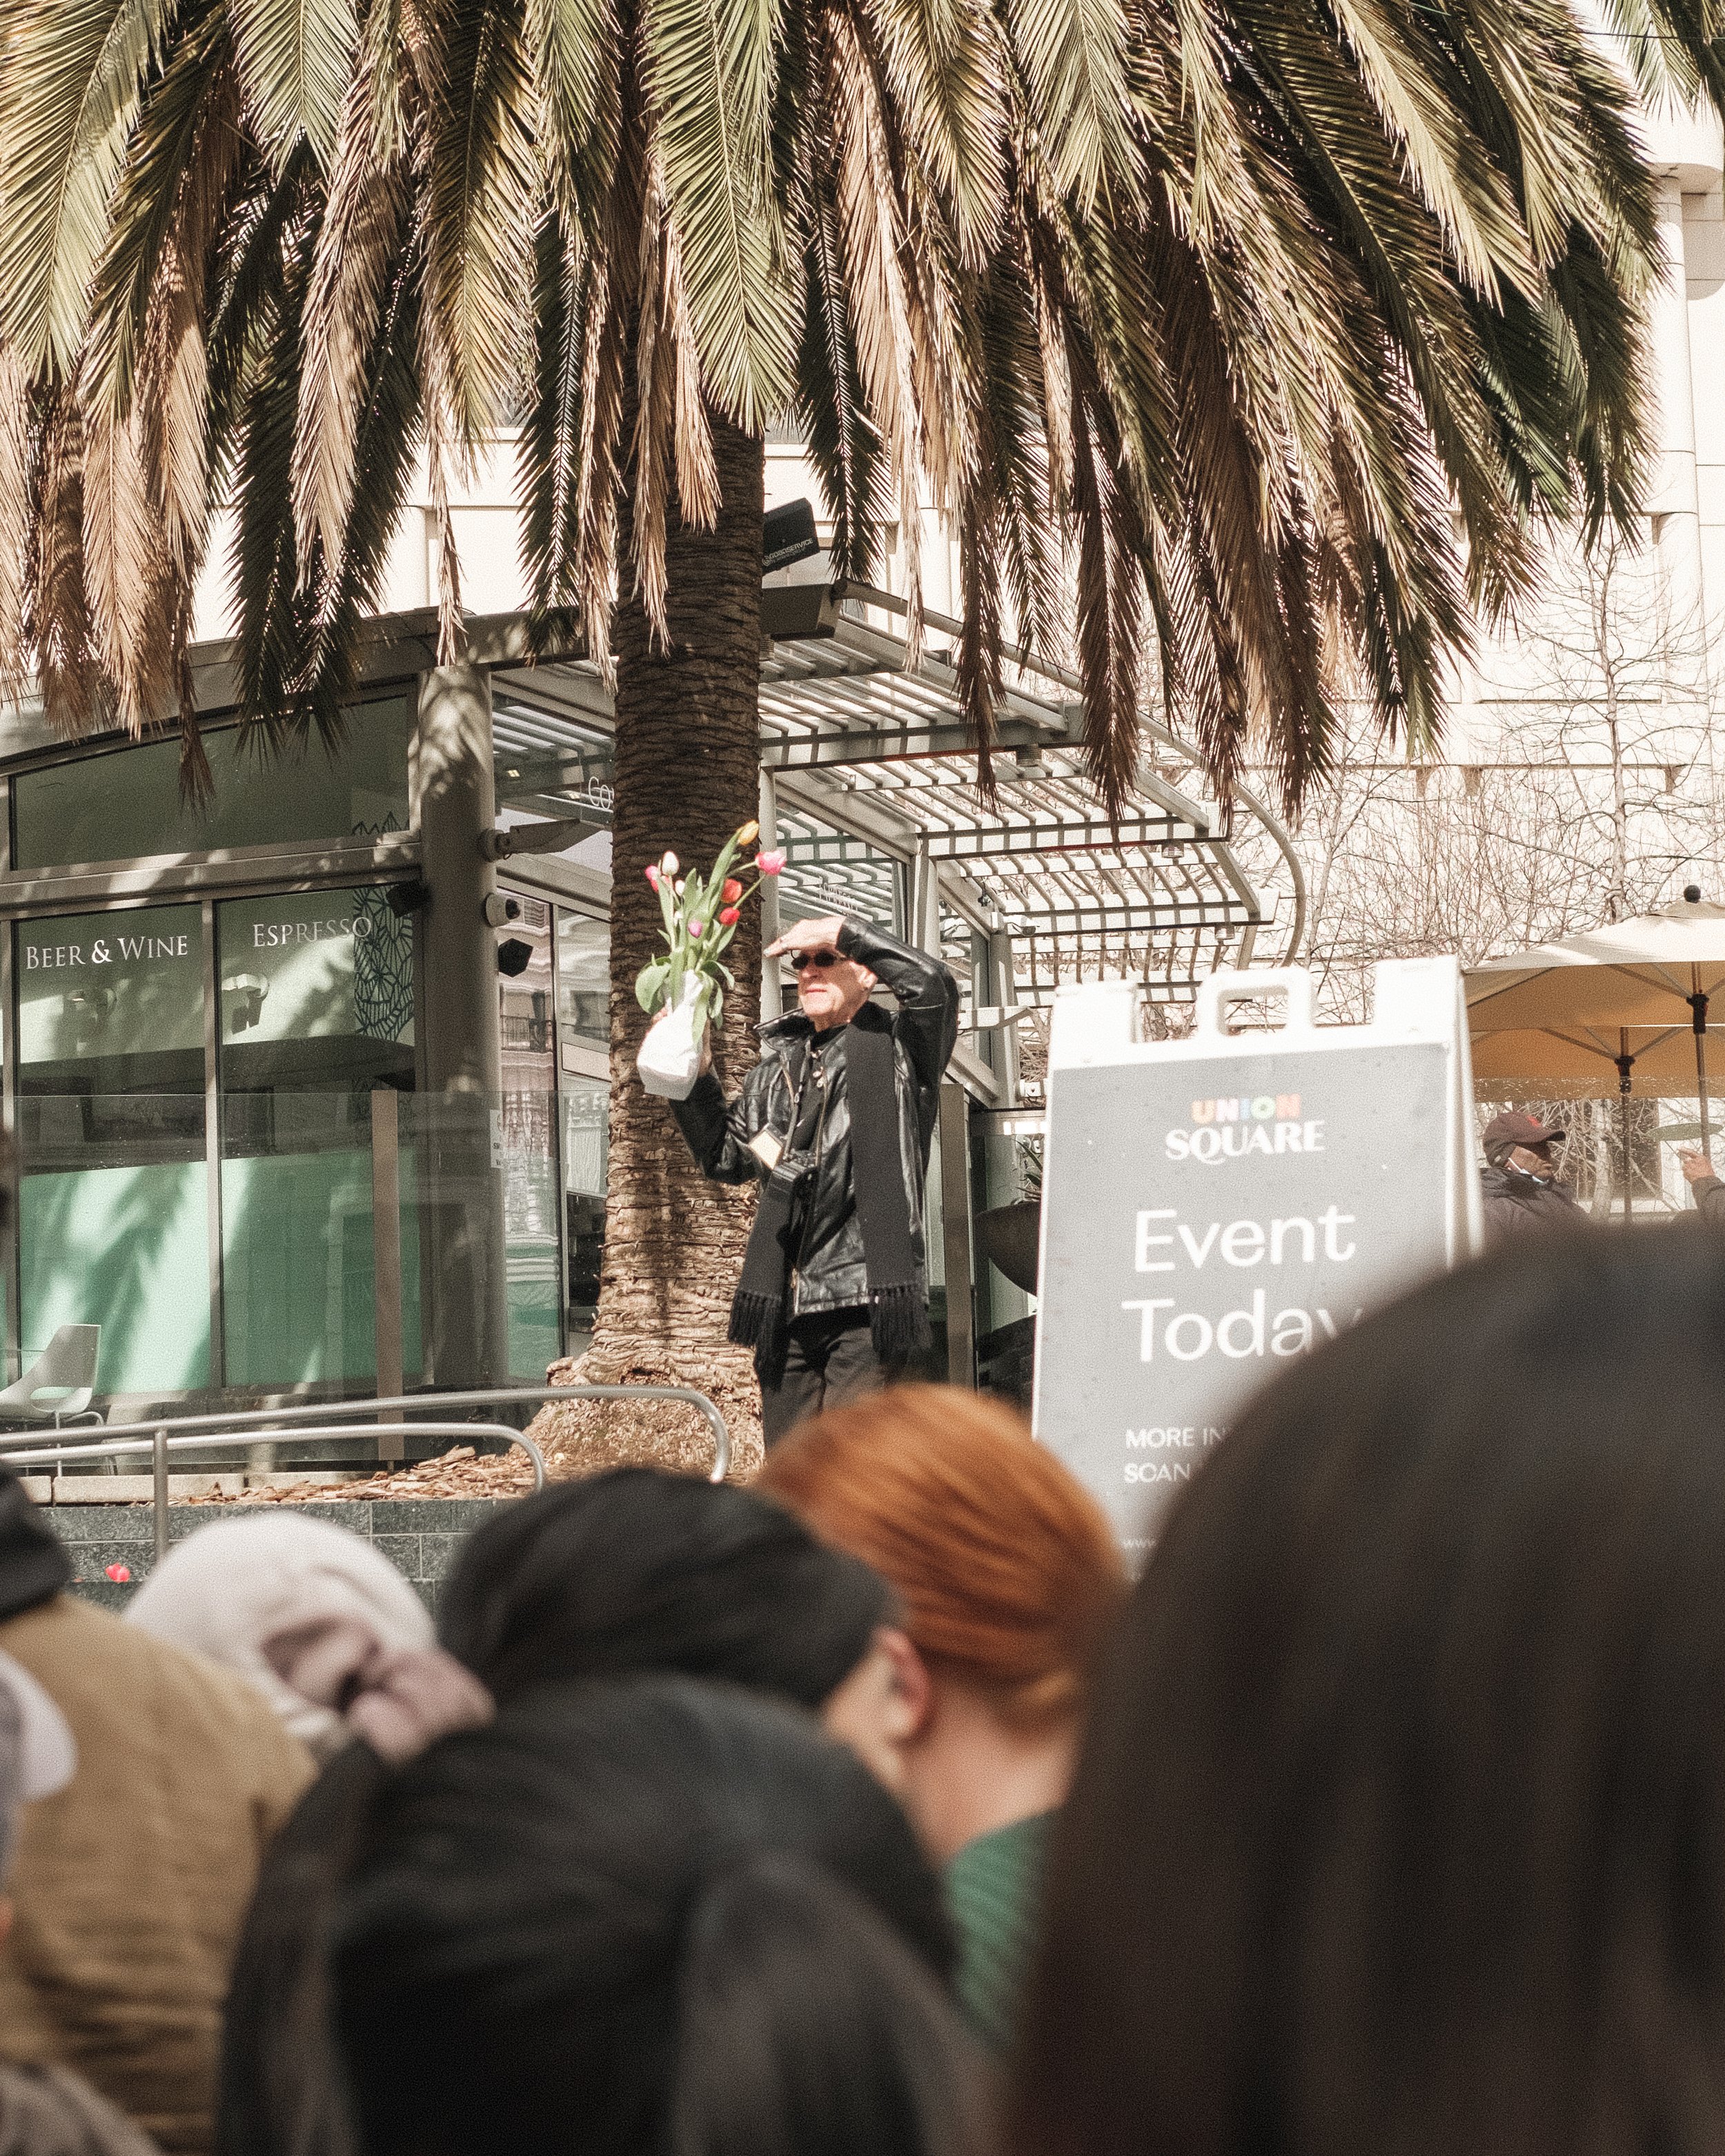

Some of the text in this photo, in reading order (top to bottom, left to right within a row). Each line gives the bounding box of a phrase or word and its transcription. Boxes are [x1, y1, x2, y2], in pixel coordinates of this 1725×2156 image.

[589, 776, 615, 809] Co
[253, 917, 372, 947] ESPRESSO
[26, 936, 188, 969] BEER & WINE
[1192, 1093, 1301, 1125] UNION
[1165, 1120, 1325, 1165] SQUARE
[1134, 1205, 1357, 1273] Event
[1125, 1426, 1195, 1449] MORE
[1124, 1462, 1191, 1483] SCAN
